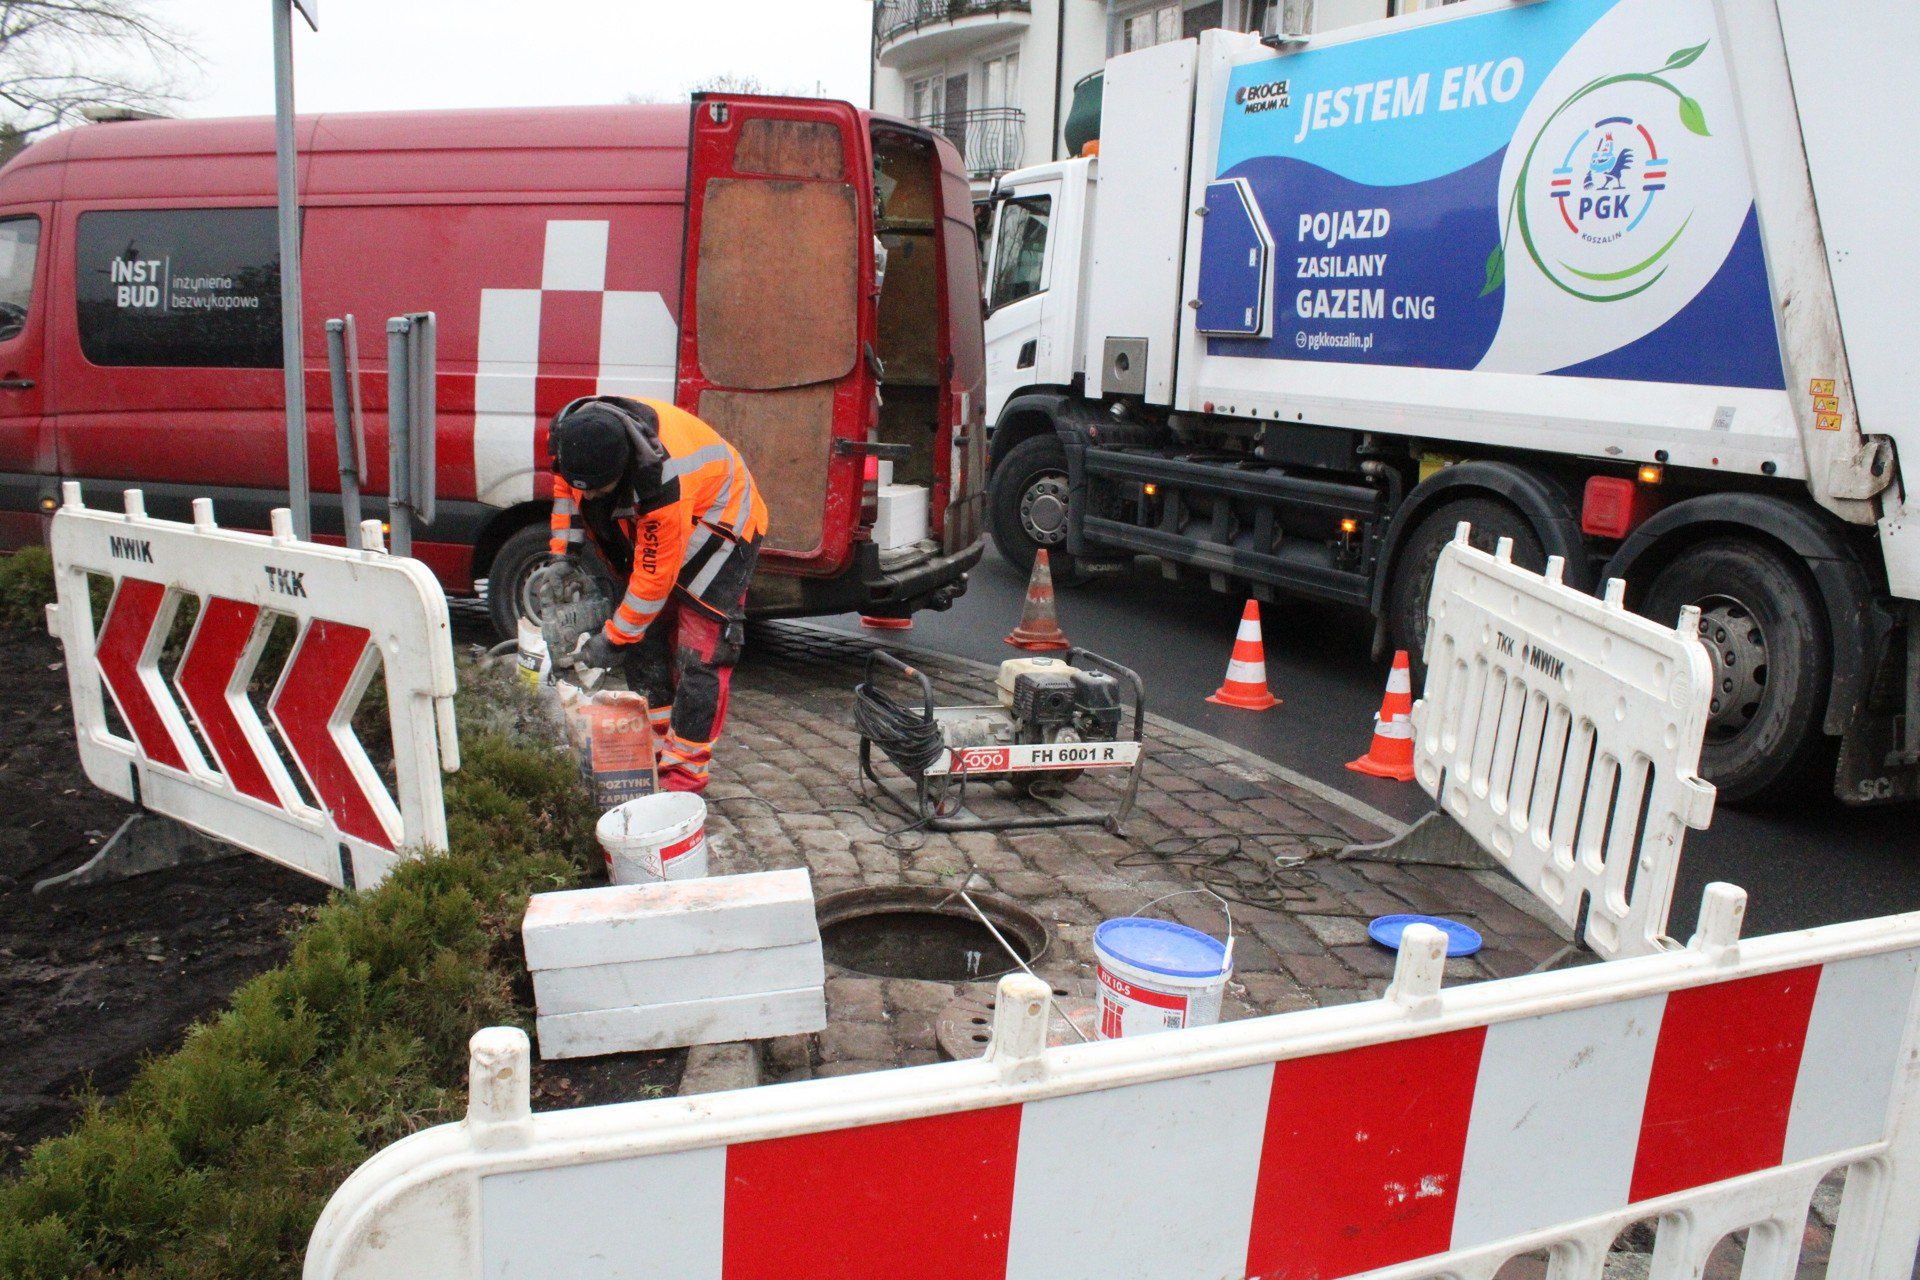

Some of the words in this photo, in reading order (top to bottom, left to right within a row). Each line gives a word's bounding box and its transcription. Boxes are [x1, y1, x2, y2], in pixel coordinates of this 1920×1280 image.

[1247, 80, 1288, 101] EKOCEL
[1294, 72, 1430, 144] JESTEM
[1438, 56, 1525, 112] EKO
[1244, 100, 1278, 115] MEDIUM
[1279, 97, 1289, 109] XL
[1578, 194, 1631, 221] PGK
[1298, 208, 1391, 249] POJAZD
[1581, 231, 1622, 244] KOSZALIN
[1296, 254, 1388, 278] ZASILANY
[116, 285, 160, 308] BUD
[171, 293, 259, 310] bezwykopowa
[1296, 289, 1385, 319] GAZEM
[1391, 296, 1436, 320] CNG
[1308, 332, 1373, 352] pgkkoszalin.pl
[109, 535, 154, 564] MWIK
[264, 565, 307, 599] TKK
[1496, 631, 1516, 658] TKK
[1530, 645, 1565, 681] MWIK
[601, 716, 645, 735] 560
[1031, 750, 1053, 763] FH
[1058, 748, 1097, 762] 6001
[1103, 747, 1115, 760] R
[1112, 978, 1131, 997] 10-S
